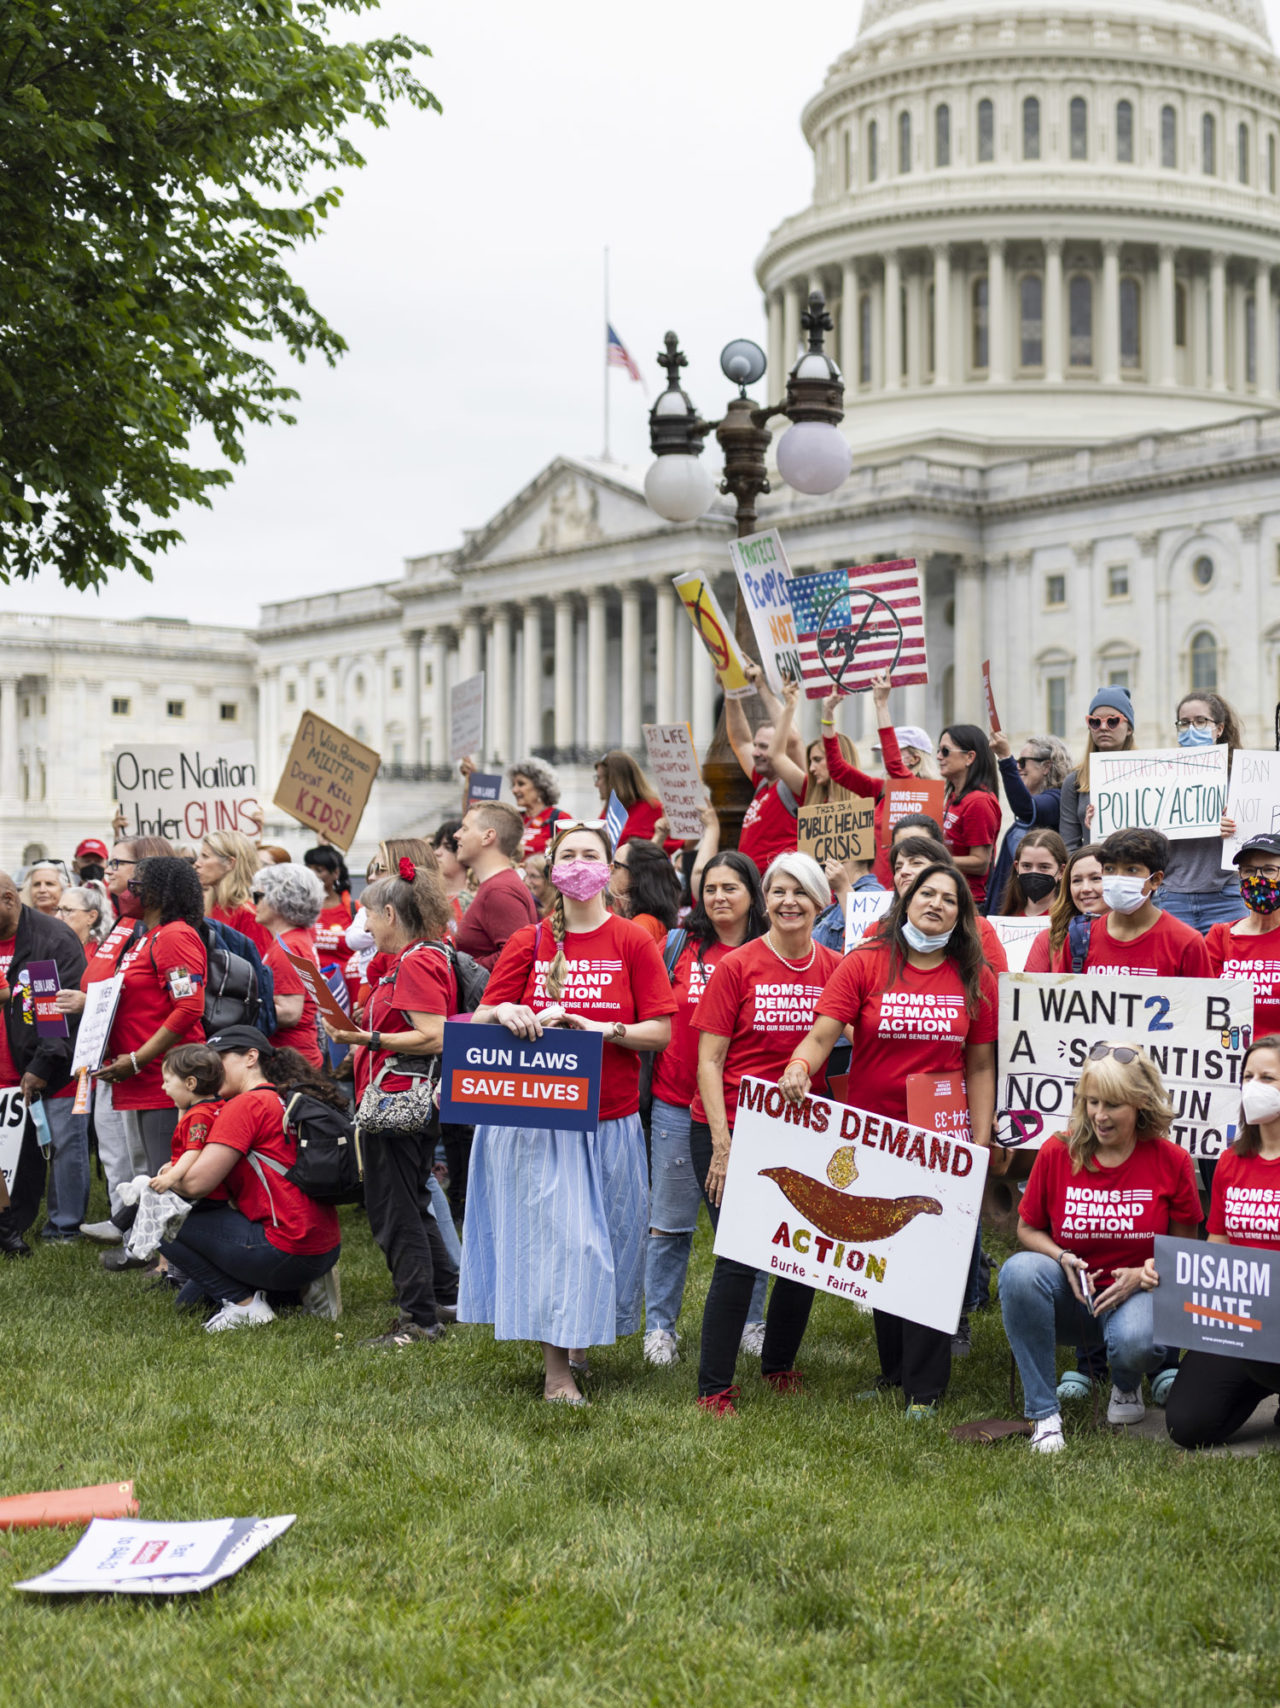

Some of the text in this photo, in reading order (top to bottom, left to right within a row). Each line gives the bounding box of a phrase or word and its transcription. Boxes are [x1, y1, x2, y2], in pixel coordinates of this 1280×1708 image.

[737, 536, 777, 569] PROTECT
[768, 613, 796, 646] NOT
[301, 719, 316, 744] A
[116, 750, 257, 791] One Nation
[1241, 758, 1270, 784] BAN
[889, 803, 922, 813] DEMAND
[890, 791, 911, 801] MOMS
[119, 799, 262, 840] Under GUNS
[295, 787, 353, 836] KIDS!
[815, 805, 835, 815] THIS
[837, 804, 846, 812] IS
[798, 809, 875, 840] PUBLIC HEALTH
[814, 833, 862, 862] CRISIS
[853, 896, 881, 913] MY
[755, 984, 804, 997] MOMS
[882, 993, 936, 1007] MOMS
[754, 1010, 814, 1023] ACTION
[880, 1006, 958, 1019] DEMAND
[1012, 988, 1231, 1032] I WANT 2 B
[878, 1018, 951, 1032] ACTION
[941, 1034, 965, 1042] AMERIC
[1009, 1030, 1037, 1064] A
[466, 1047, 579, 1071] GUN LAWS
[460, 1077, 581, 1102] SAVE LIVES
[1008, 1075, 1076, 1113] NOT
[738, 1078, 974, 1178] MOMS DEMAND
[1066, 1187, 1122, 1203] MOMS
[1227, 1186, 1274, 1203] MOMS
[1064, 1201, 1145, 1218] DEMAND
[1061, 1217, 1134, 1231] ACTION
[1061, 1231, 1073, 1239] FOR
[1074, 1231, 1089, 1239] GUN
[1123, 1231, 1156, 1239] AMERICA
[1225, 1217, 1280, 1232] ACTION
[771, 1221, 888, 1284] ACTION
[770, 1255, 869, 1299] Burke Fairfax
[1176, 1250, 1271, 1297] DISARM
[1192, 1290, 1254, 1335] HATE
